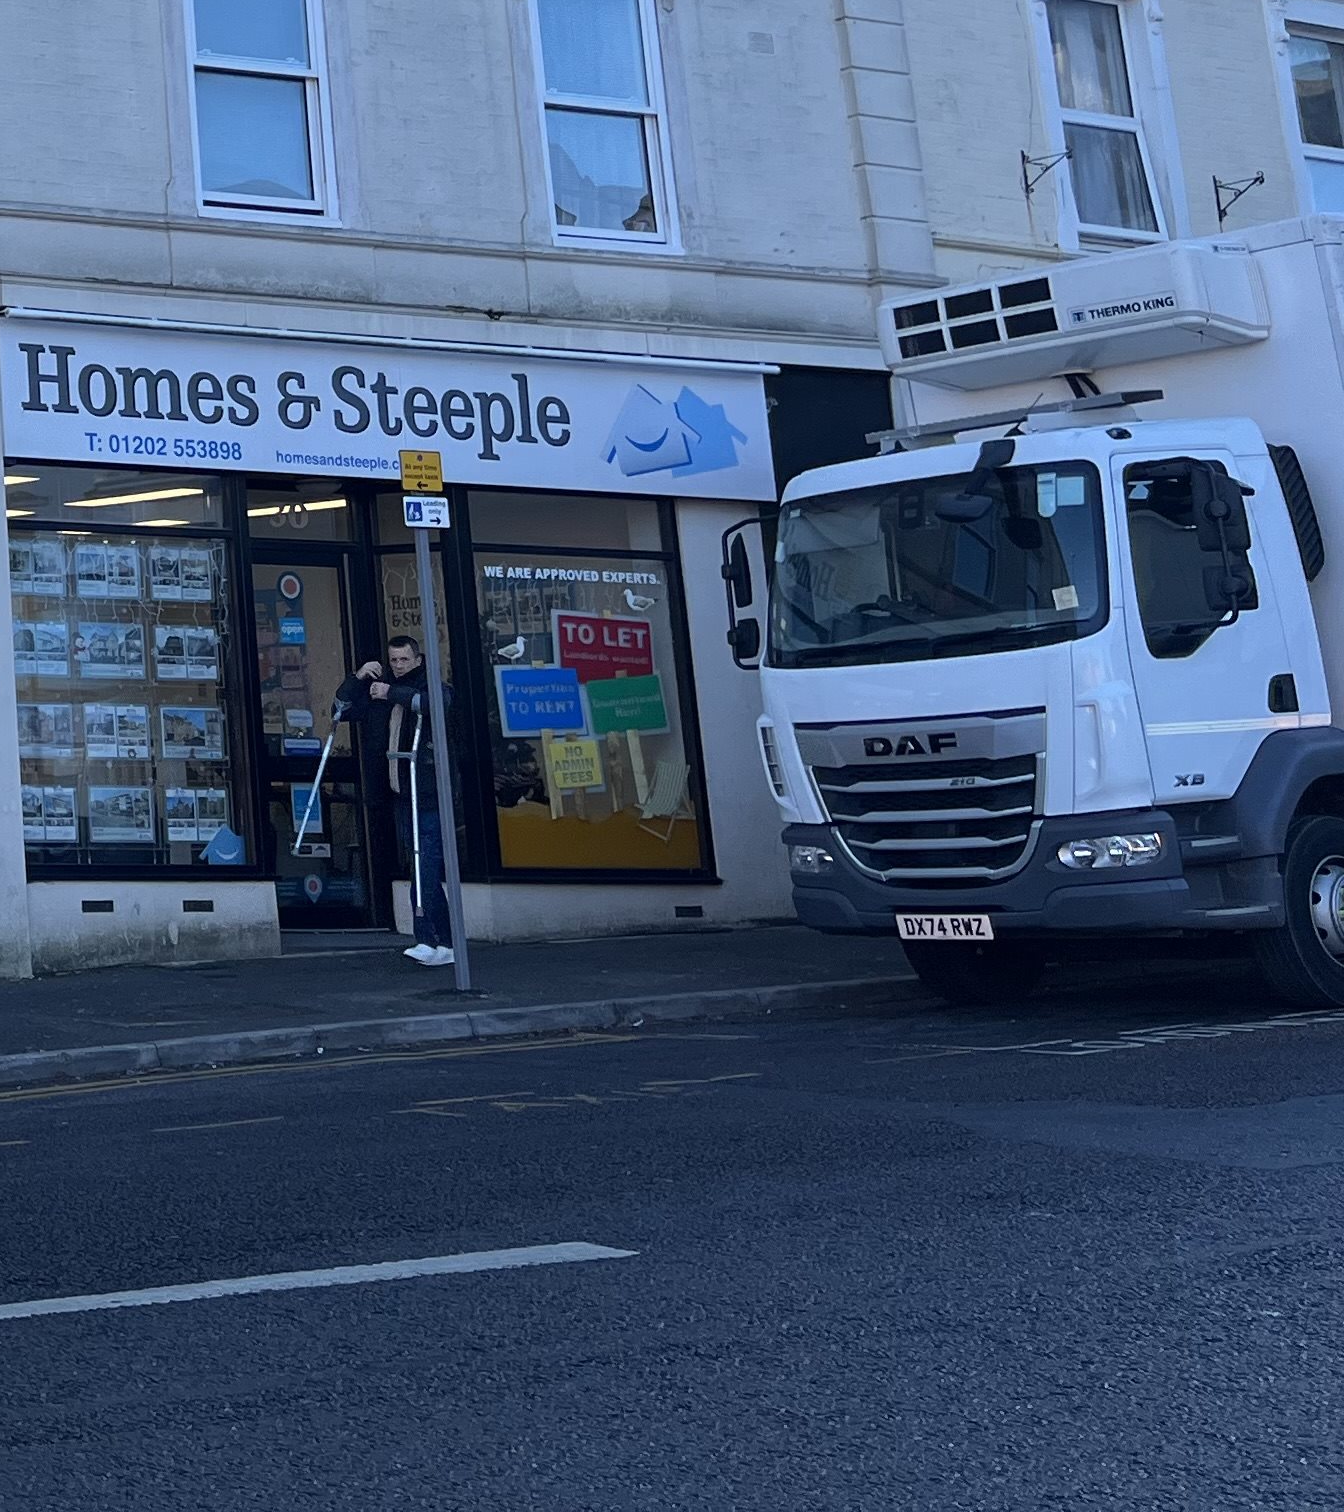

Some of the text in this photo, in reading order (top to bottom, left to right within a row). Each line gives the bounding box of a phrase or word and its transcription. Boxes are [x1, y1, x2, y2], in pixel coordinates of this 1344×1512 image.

[1088, 294, 1175, 321] THERMO KING
[18, 343, 573, 462] Homes & Steeple
[85, 432, 244, 462] T: 01202 553898
[275, 449, 399, 473] homesandsteeple.c
[269, 501, 309, 528] 30
[484, 564, 661, 584] WE ARE APPROVED EXPERTS.
[562, 622, 648, 648] TO LET
[509, 700, 575, 715] TO RENT
[564, 746, 583, 756] NO
[863, 732, 958, 757] DAF
[554, 758, 594, 771] ADMIN
[562, 771, 594, 784] FEES
[904, 917, 986, 938] DX74 RWZ
